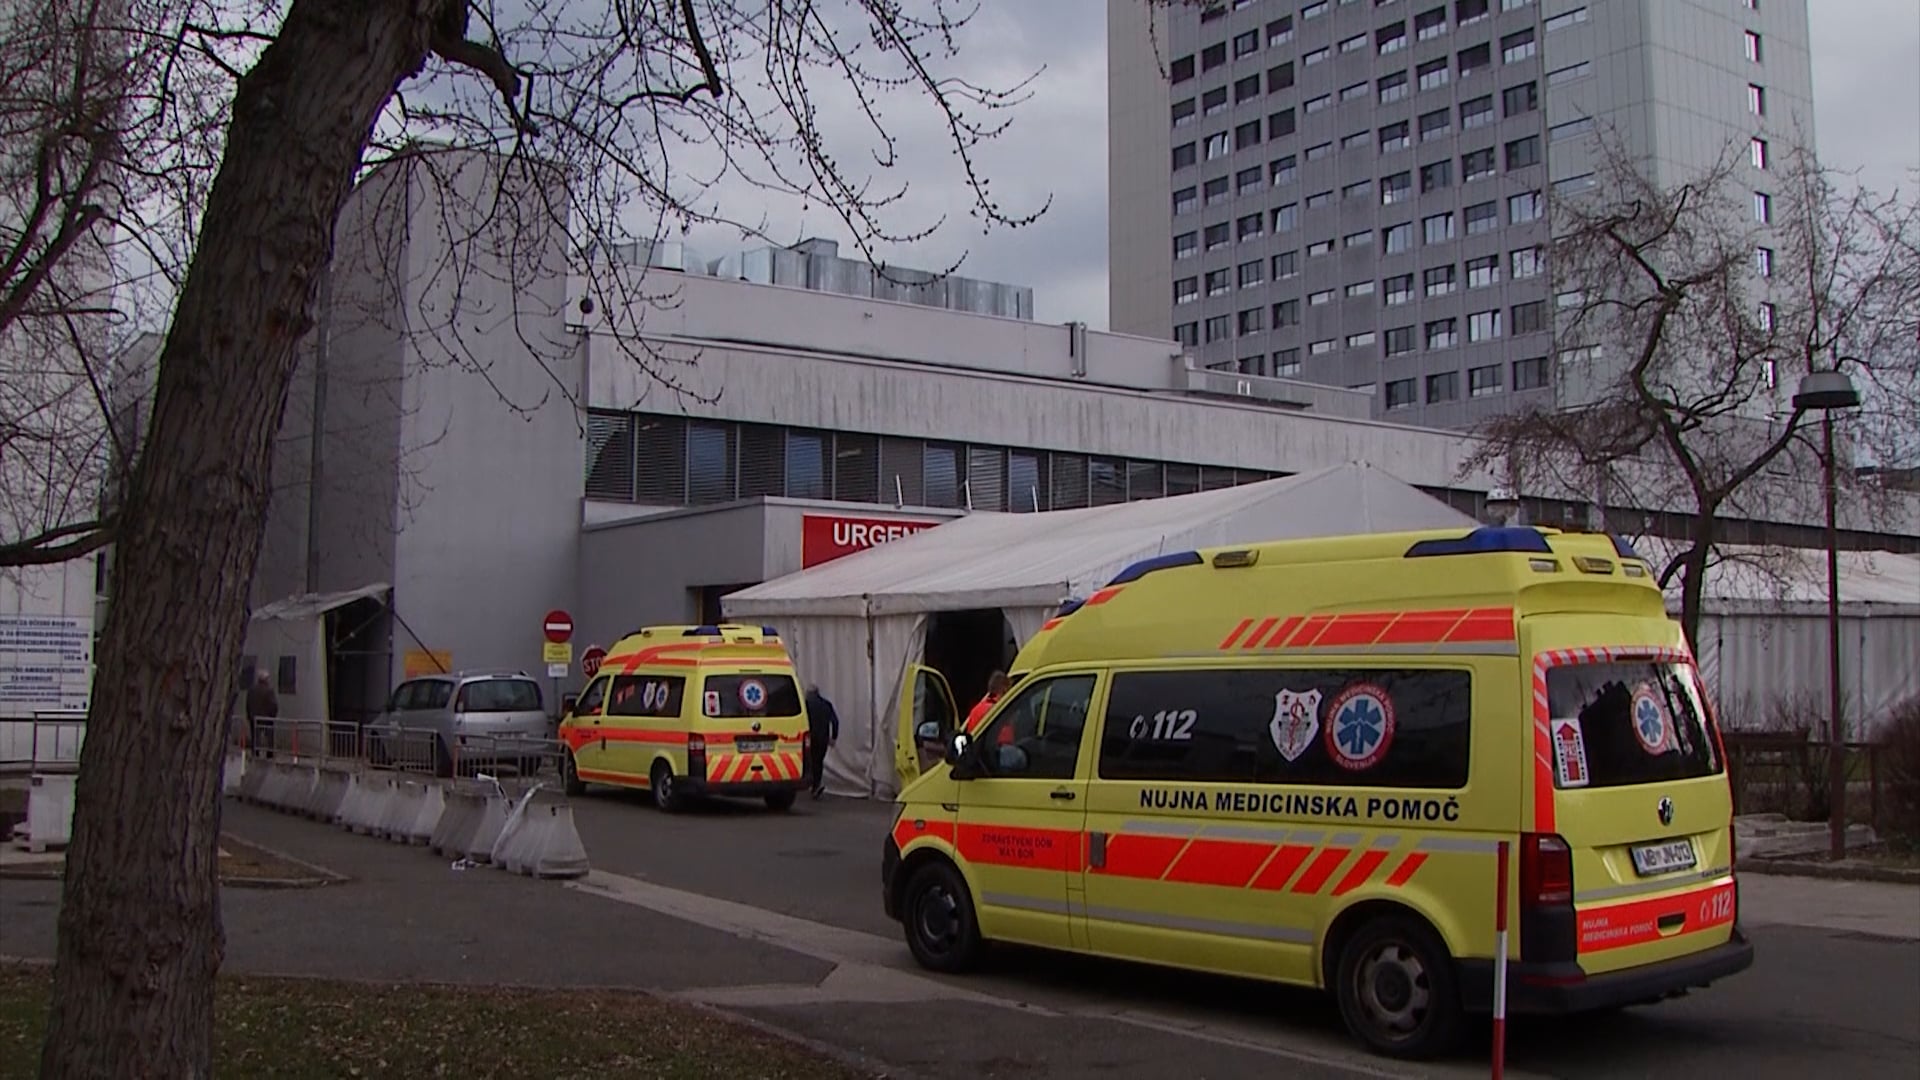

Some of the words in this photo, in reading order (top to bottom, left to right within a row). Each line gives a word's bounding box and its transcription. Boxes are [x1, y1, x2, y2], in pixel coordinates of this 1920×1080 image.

[584, 657, 602, 672] STO
[1152, 710, 1197, 740] 112
[1139, 789, 1208, 811] NUJNA
[1215, 792, 1359, 818] MEDICINSKA
[1367, 796, 1460, 822] POMOČ
[1711, 889, 1731, 919] 112
